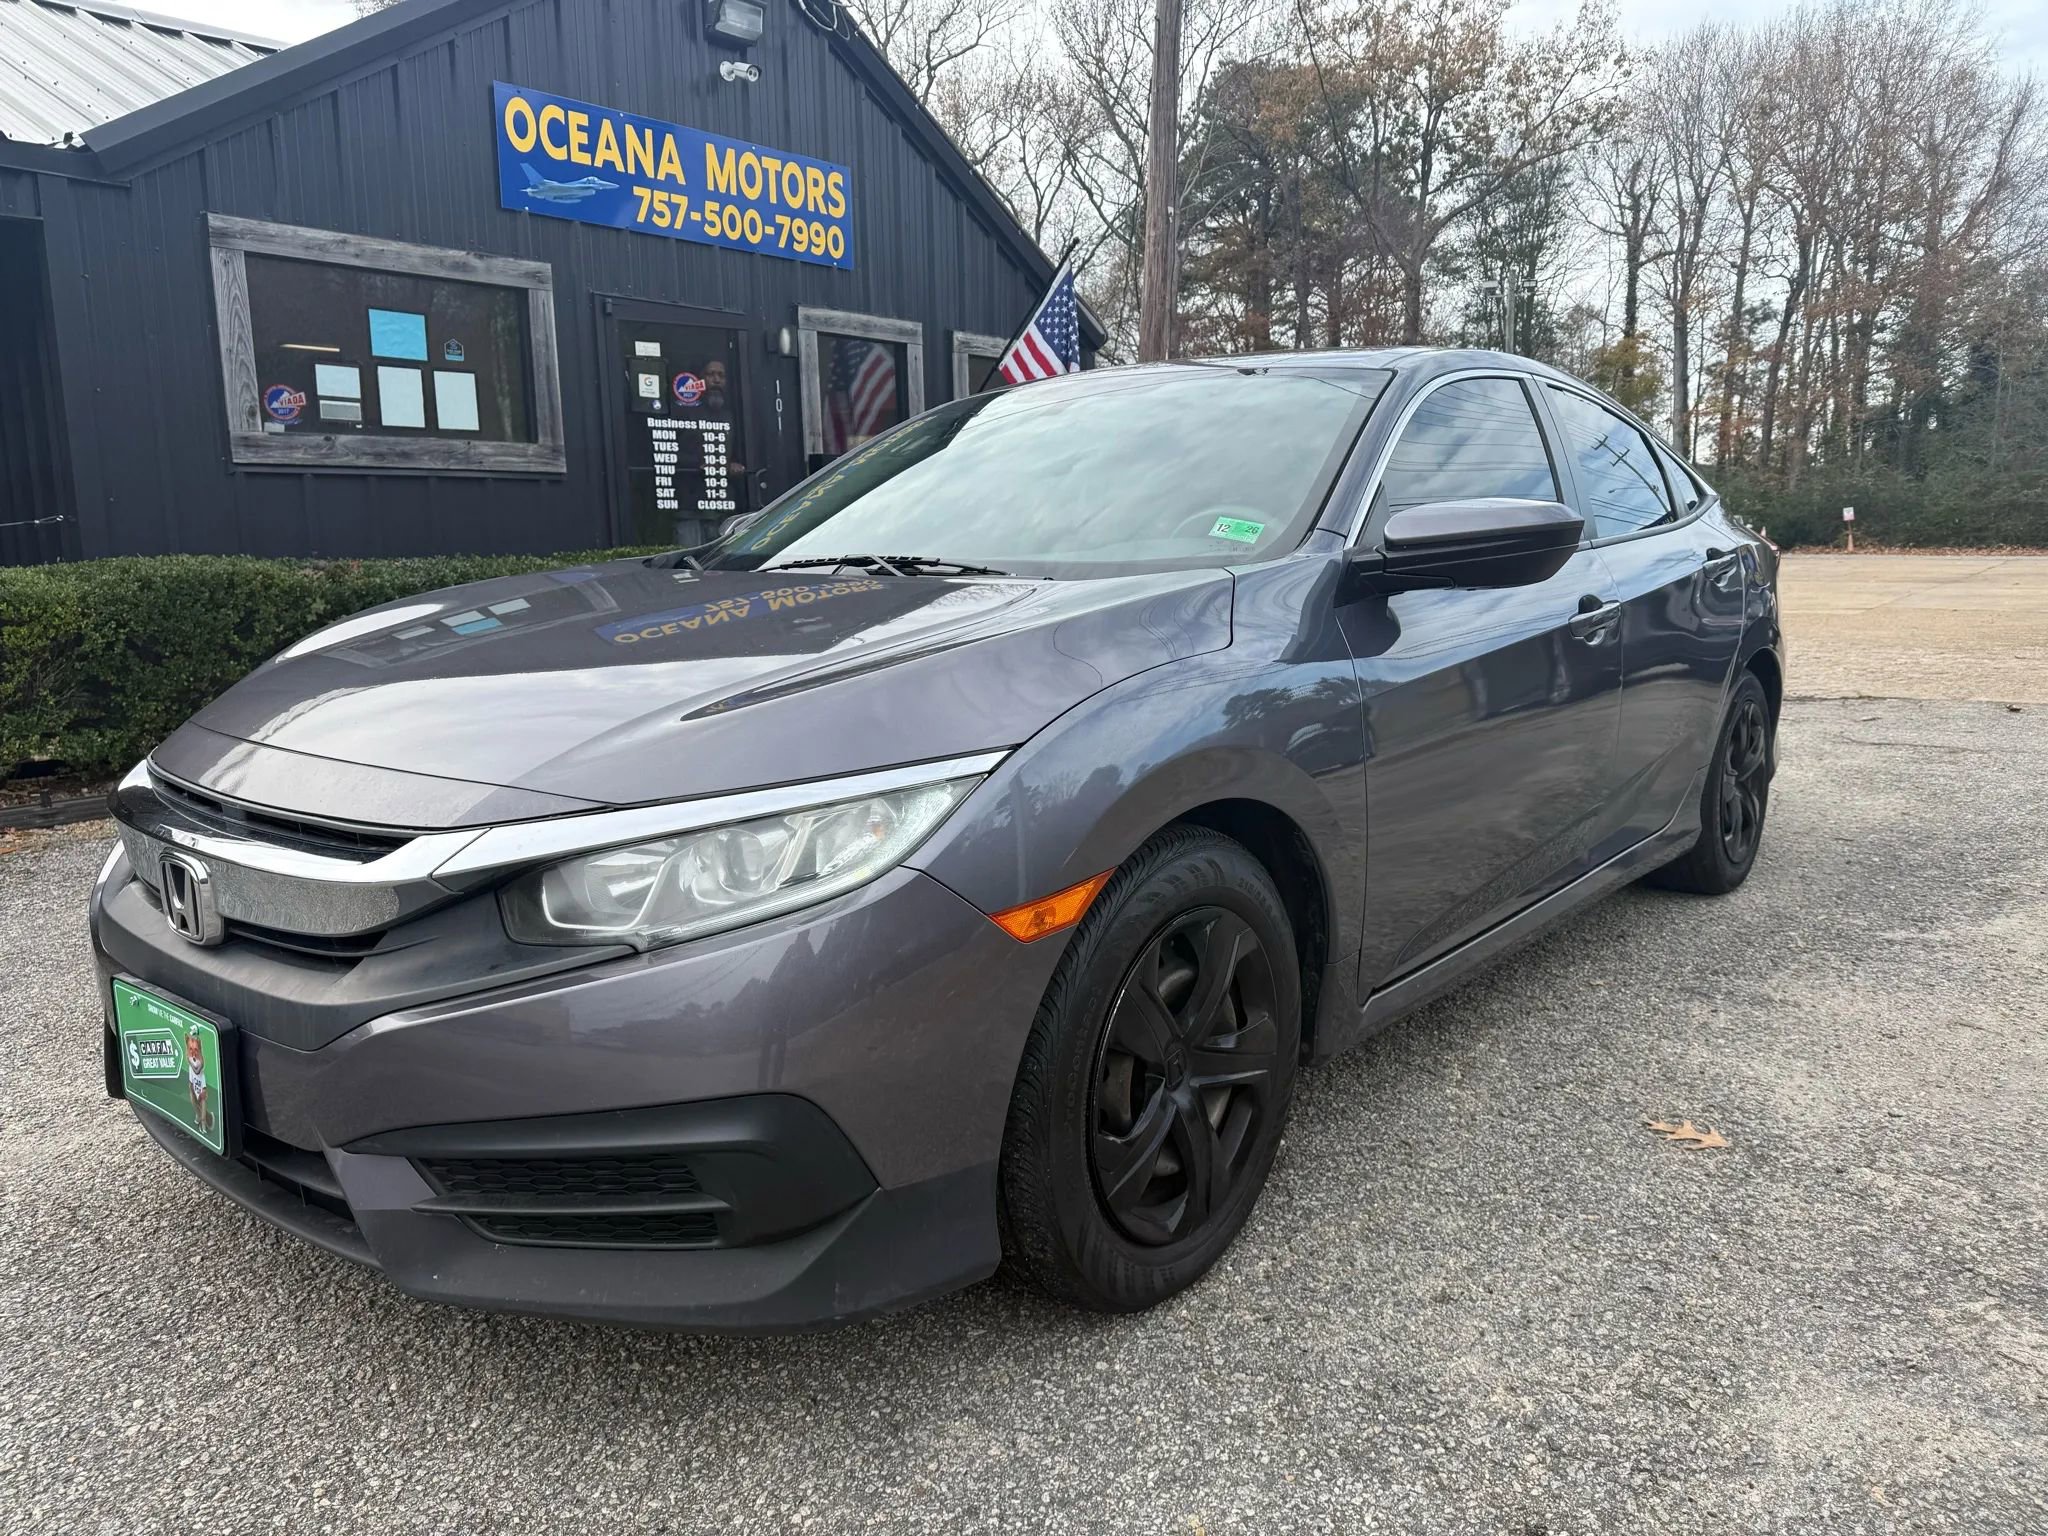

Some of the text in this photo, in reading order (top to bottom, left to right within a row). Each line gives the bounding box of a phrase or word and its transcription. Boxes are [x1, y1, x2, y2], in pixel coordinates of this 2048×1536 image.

[504, 96, 846, 219] OCEANA MOTORS
[632, 185, 845, 260] 757-500-7990
[279, 394, 304, 407] VIADA
[647, 417, 731, 431] Business Hours
[652, 430, 726, 442] MON 10-6
[652, 441, 726, 453] TUES 10-6
[653, 453, 727, 465] WED 10-6
[654, 464, 727, 476] THU 10-6
[655, 476, 728, 487] FRI 10-6
[656, 488, 727, 499] SAT 11-5
[657, 499, 736, 510] SUN CLOSED
[1216, 523, 1260, 535] 12 26
[140, 1040, 173, 1055] CARFAX
[143, 1057, 176, 1068] GREAT VALUE
